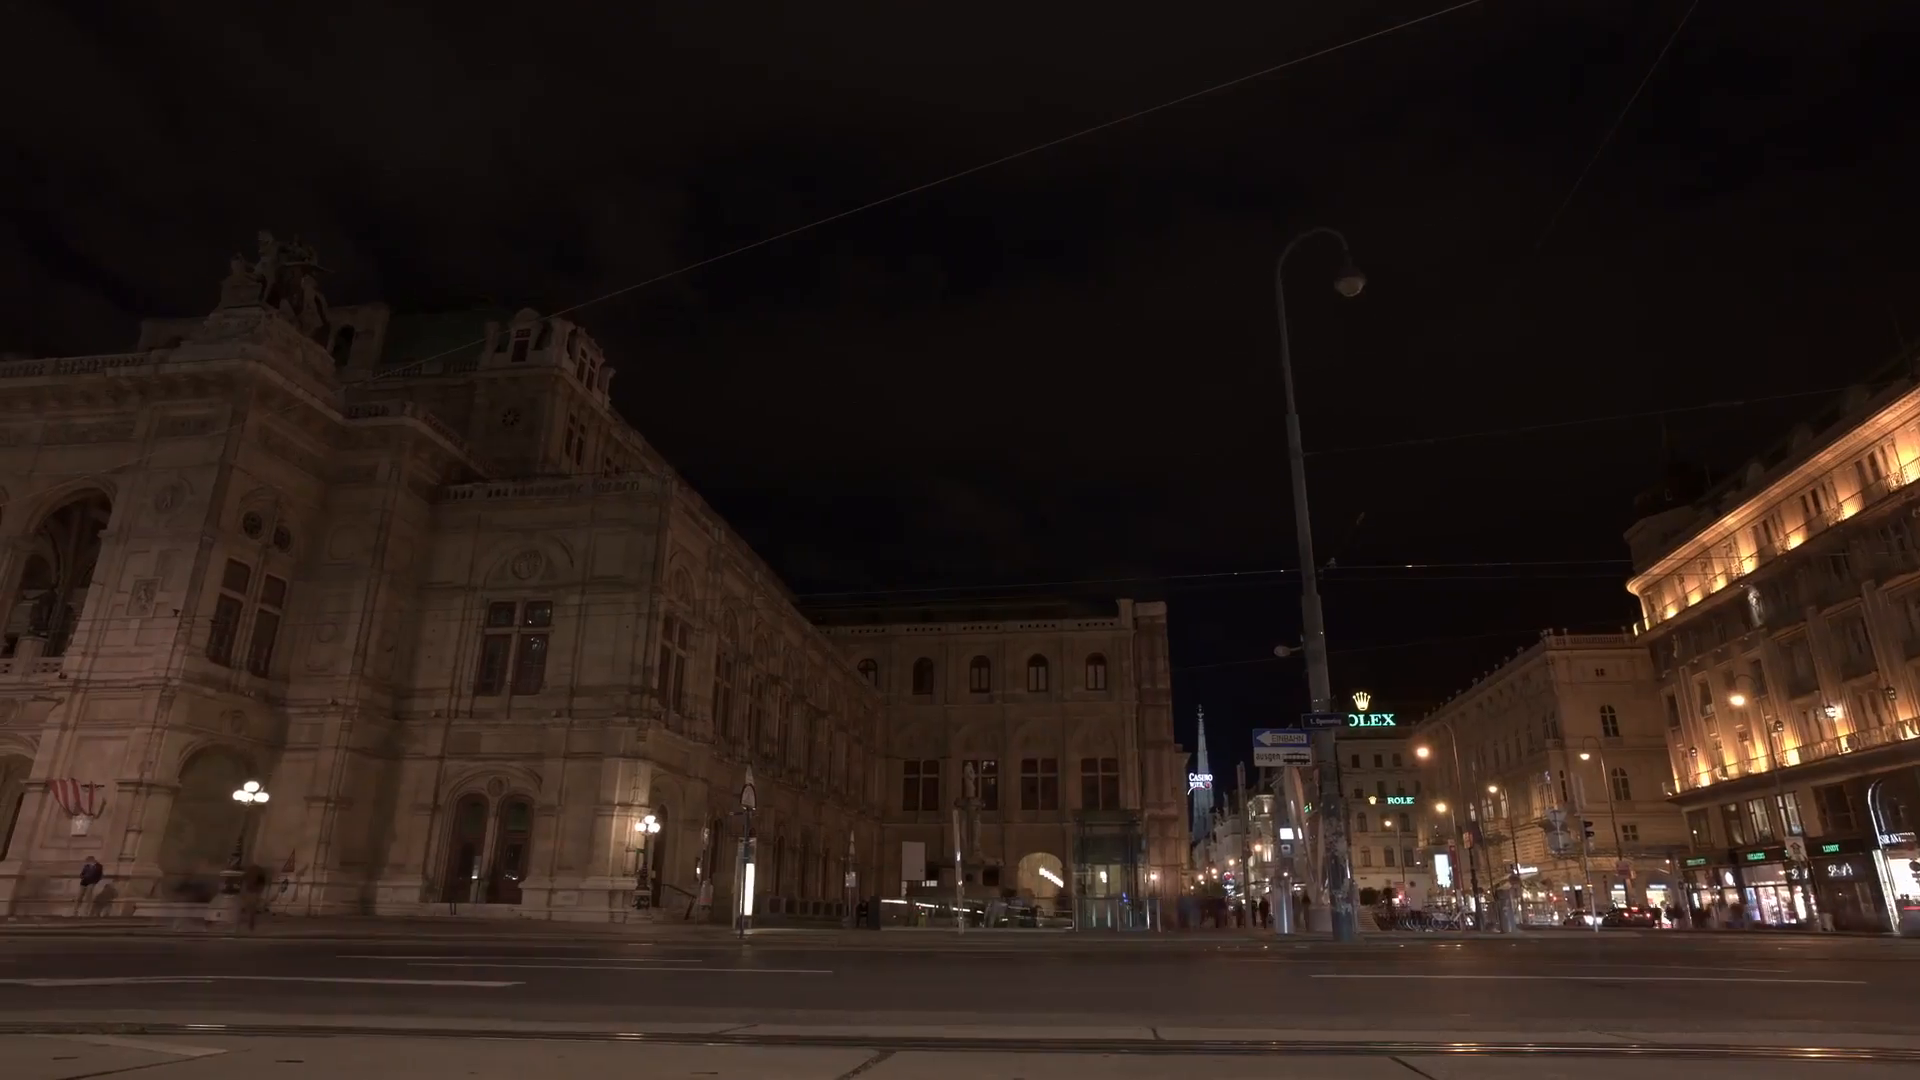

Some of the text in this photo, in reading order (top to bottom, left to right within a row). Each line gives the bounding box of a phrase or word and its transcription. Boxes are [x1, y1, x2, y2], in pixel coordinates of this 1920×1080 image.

[1348, 713, 1396, 727] OLEX
[1271, 734, 1304, 744] EINBAHN
[1387, 797, 1414, 805] ROLE
